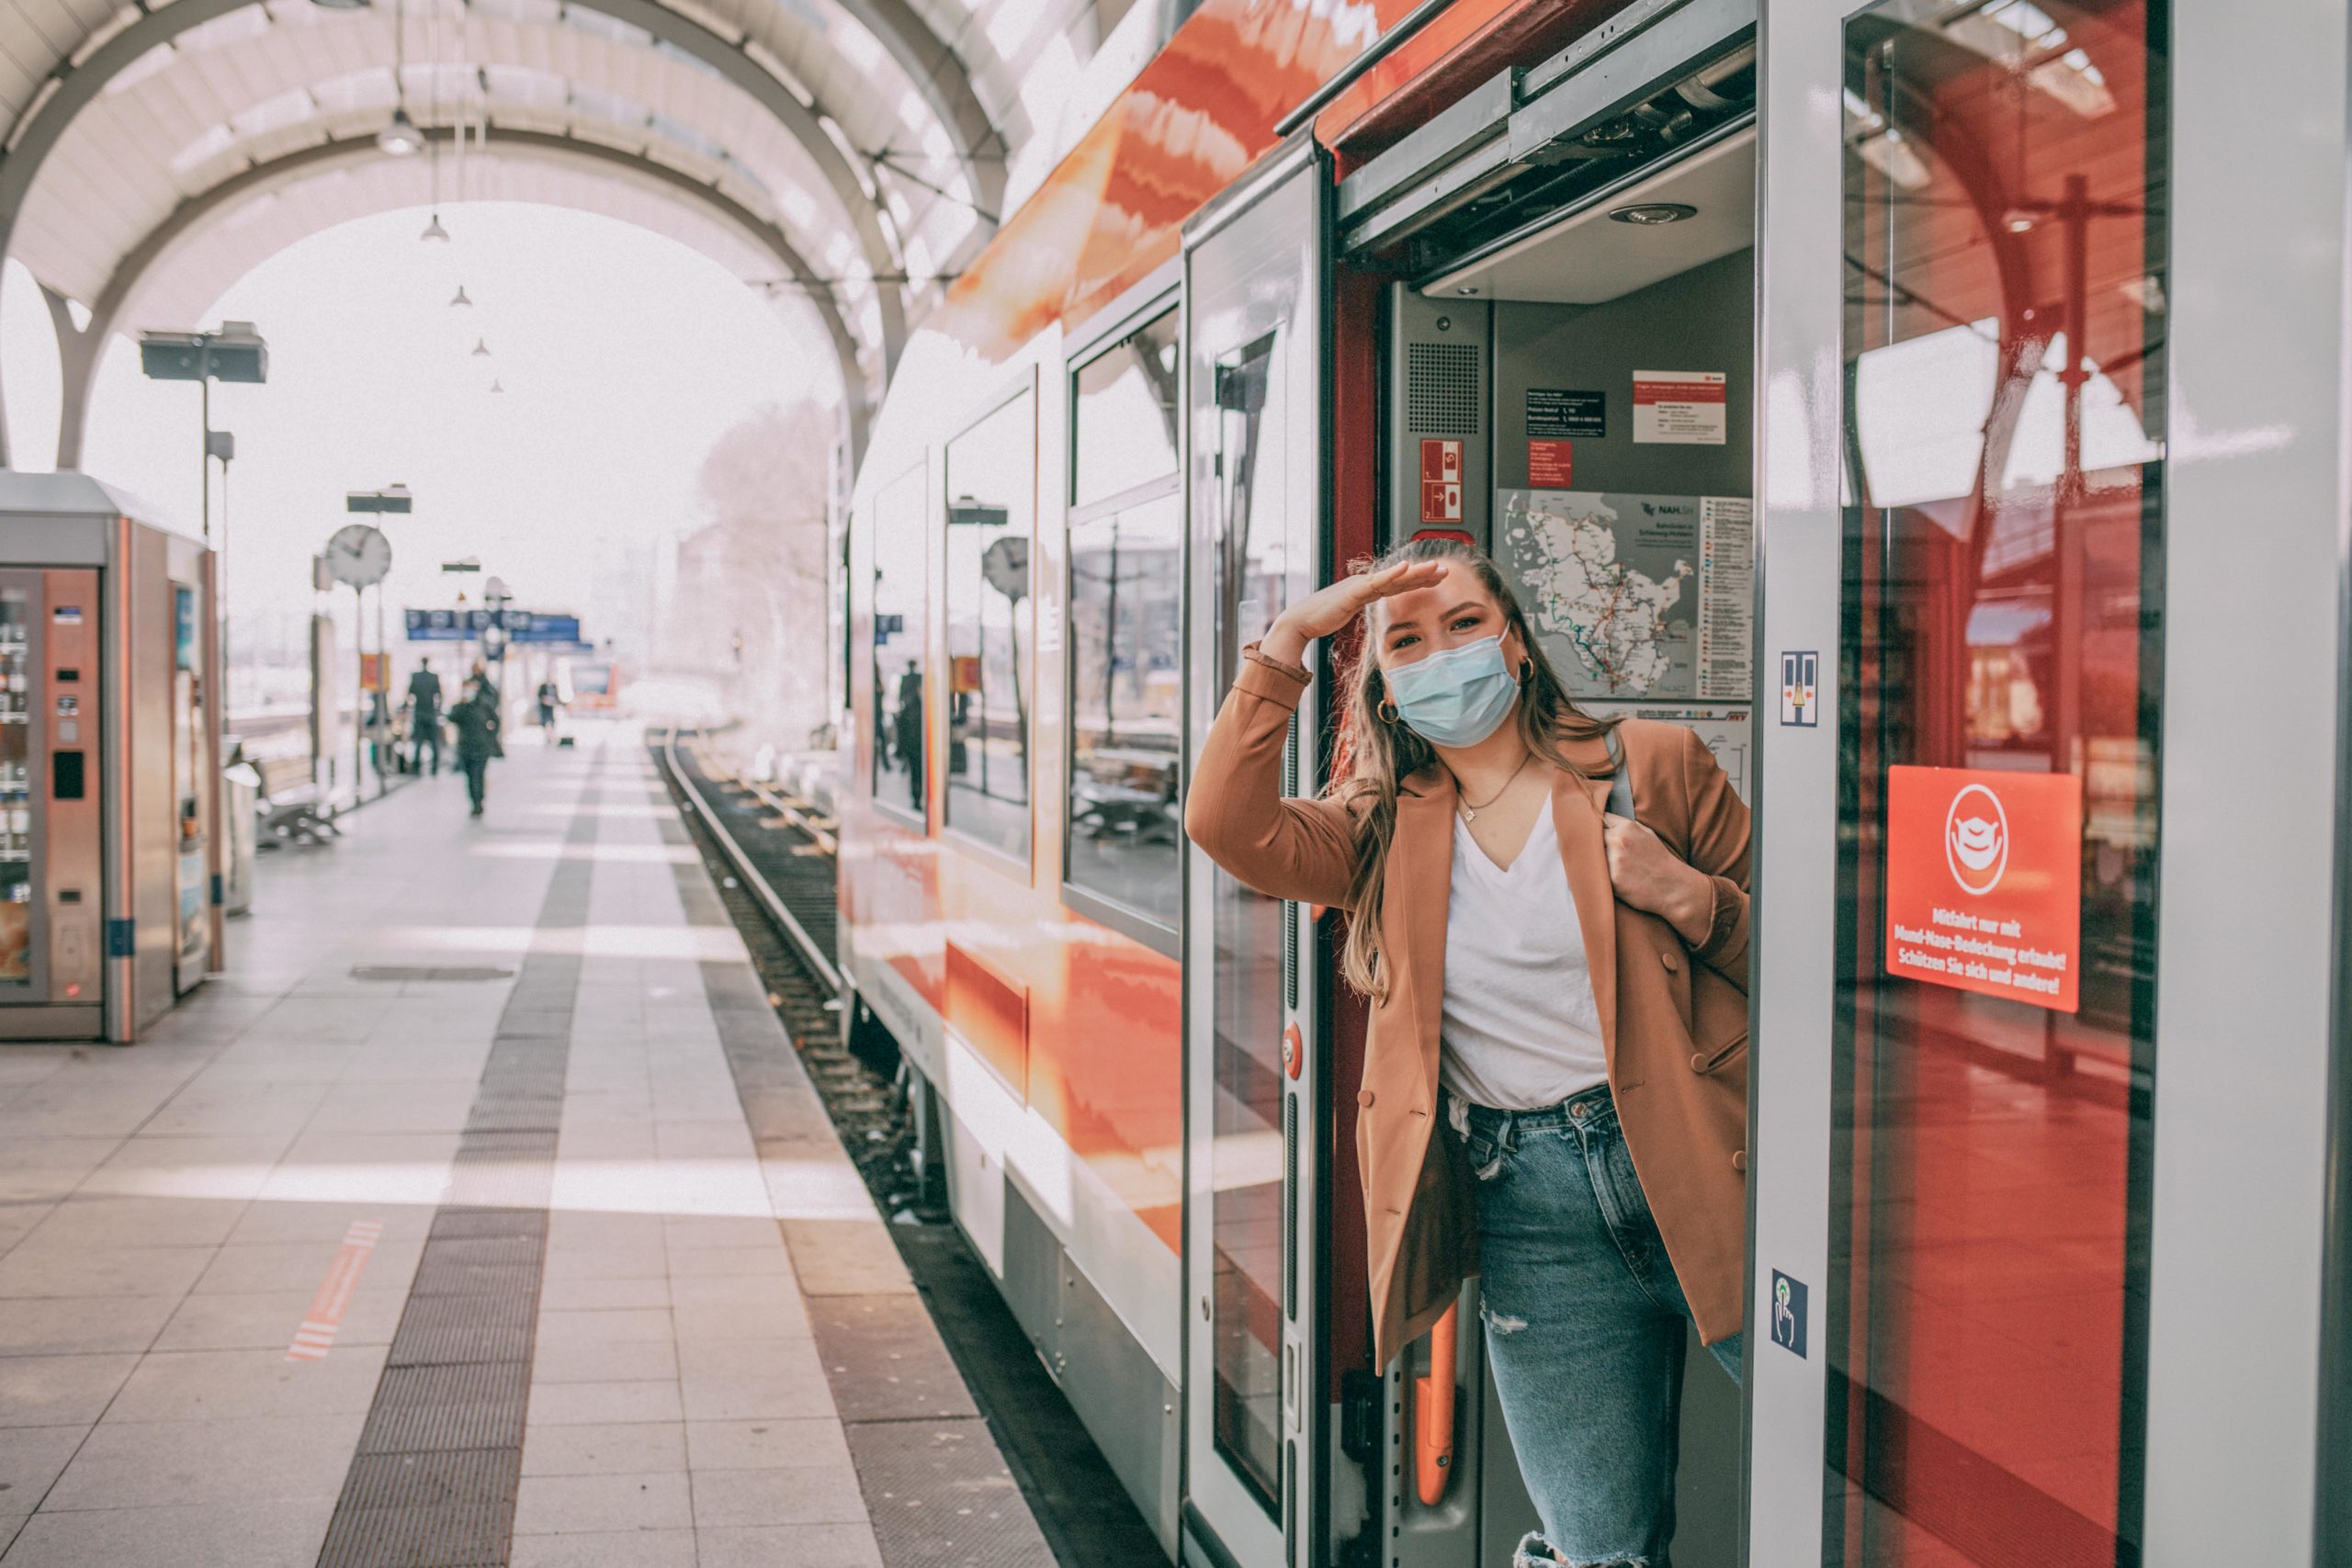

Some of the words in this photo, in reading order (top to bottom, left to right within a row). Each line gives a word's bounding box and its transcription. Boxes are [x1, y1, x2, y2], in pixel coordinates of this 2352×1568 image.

[1932, 908, 1978, 931] Mitfahrt
[1978, 919, 1999, 933] nur
[2000, 919, 2021, 938] mit
[1894, 924, 2017, 965] Mund-Nase-Bedeckung
[2018, 947, 2067, 971] erlaubt!
[1898, 947, 1946, 972] Schützen
[1947, 956, 1964, 976] Sie
[1965, 960, 1987, 980] sich
[1989, 968, 2012, 985] und
[2013, 973, 2060, 995] andere!
